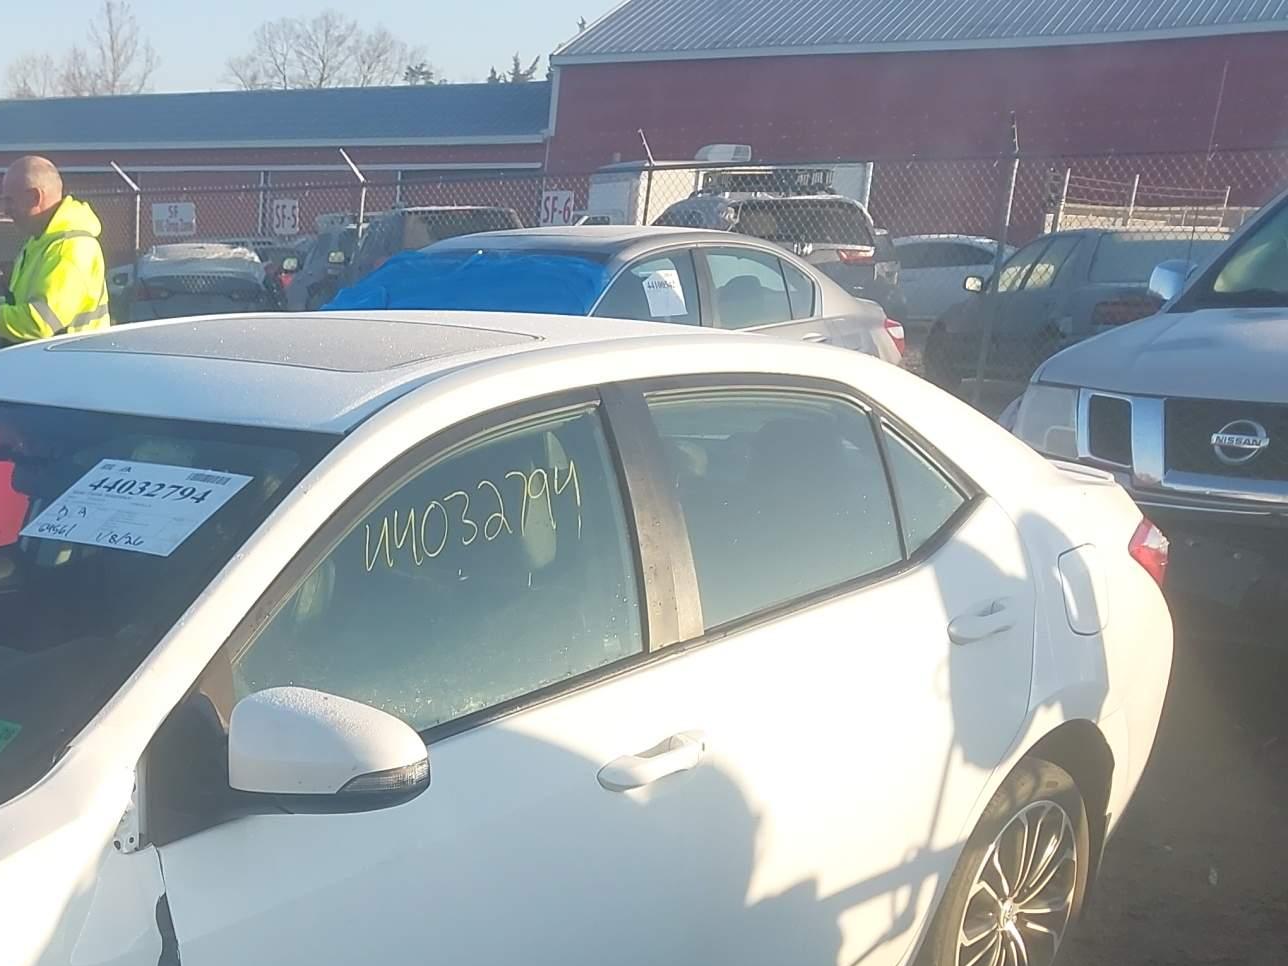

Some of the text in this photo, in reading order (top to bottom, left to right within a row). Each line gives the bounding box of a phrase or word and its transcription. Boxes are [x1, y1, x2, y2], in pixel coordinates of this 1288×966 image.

[542, 195, 571, 224] SF-6
[1215, 435, 1262, 446] NISSAN
[88, 477, 213, 504] 44032794
[364, 460, 583, 572] 44032794
